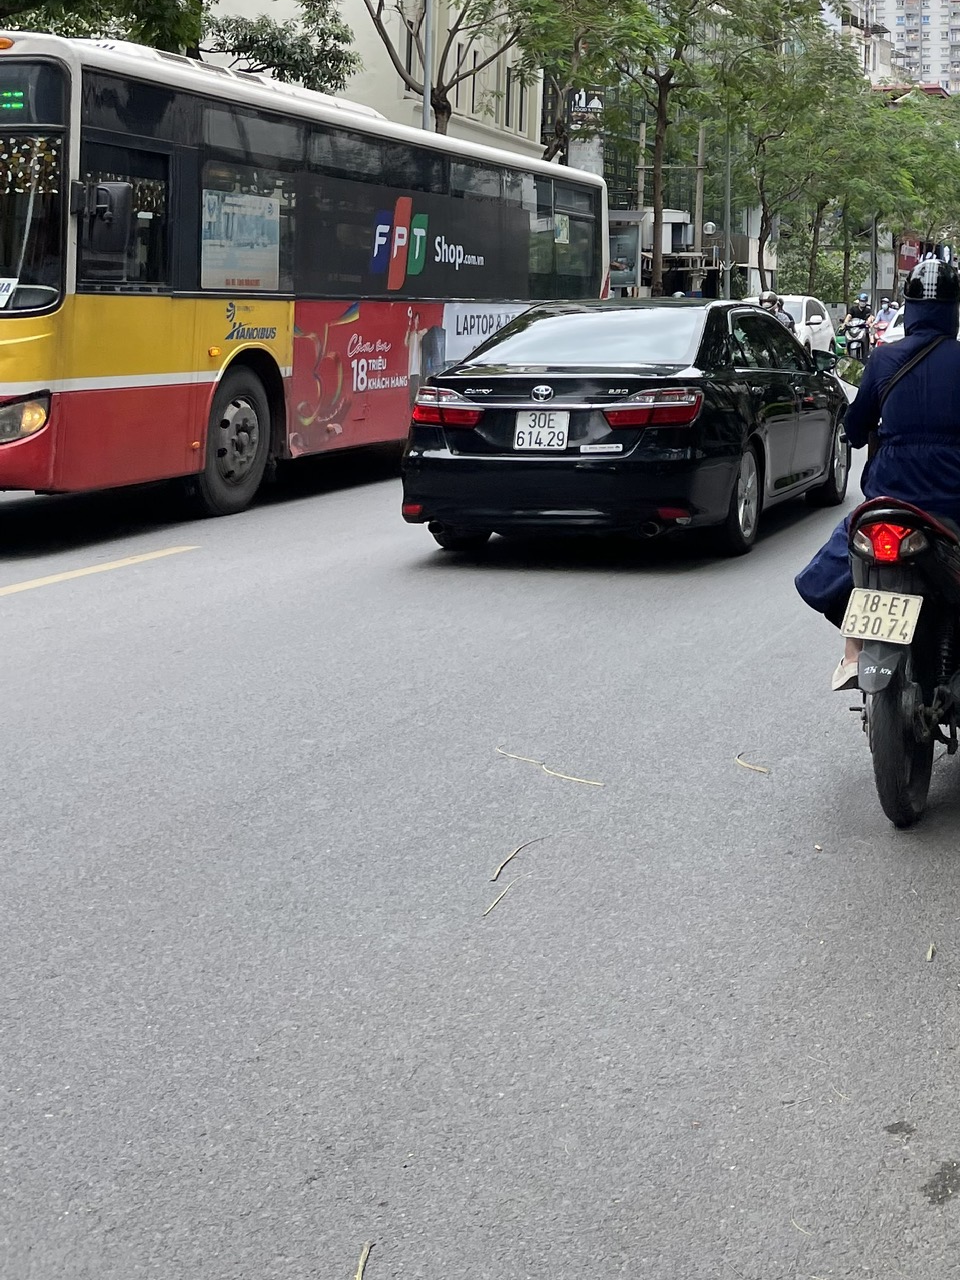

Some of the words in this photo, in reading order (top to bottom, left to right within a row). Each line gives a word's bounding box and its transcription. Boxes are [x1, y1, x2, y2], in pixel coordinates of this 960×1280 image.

[373, 224, 426, 260] FPT
[224, 321, 277, 340] HANOIBUS
[456, 314, 495, 336] LAPTOP
[351, 358, 368, 392] 18
[368, 373, 390, 390] KHÁCH
[390, 373, 408, 388] HÀNG
[528, 412, 556, 429] 30E
[516, 430, 565, 448] 614.29
[862, 593, 910, 618] 18-E1
[846, 614, 908, 640] 330.74
